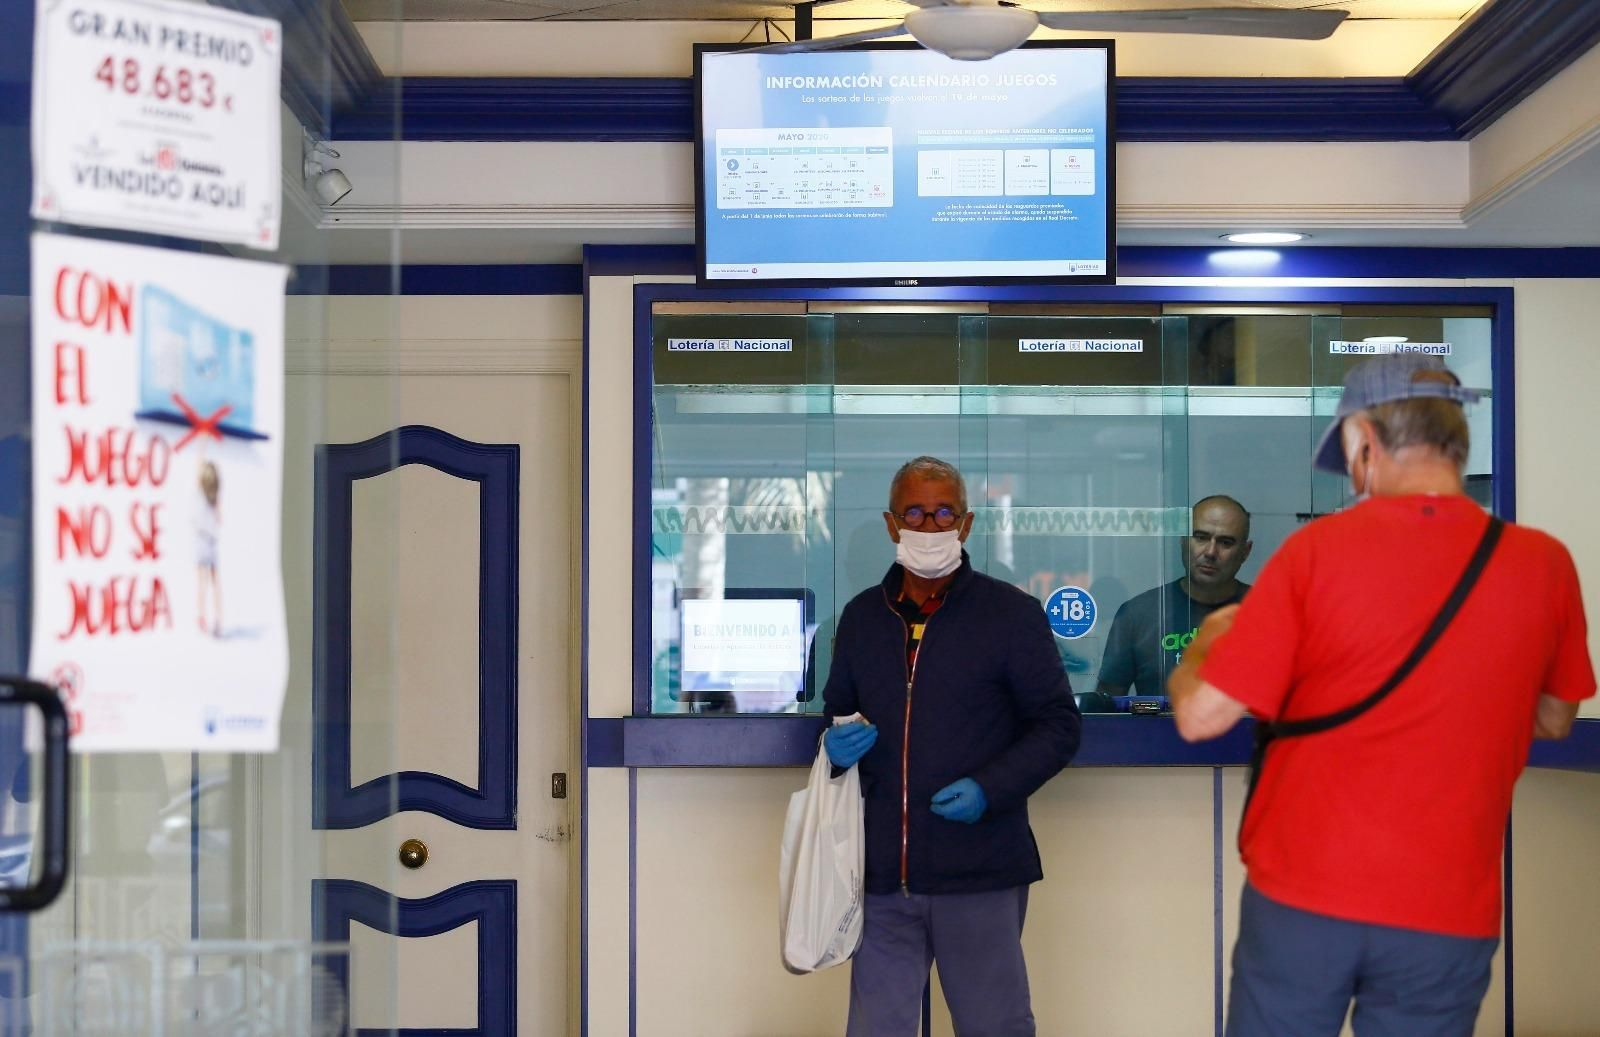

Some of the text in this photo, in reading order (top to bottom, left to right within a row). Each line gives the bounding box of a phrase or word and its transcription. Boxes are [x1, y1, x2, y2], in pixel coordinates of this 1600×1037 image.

[67, 9, 254, 68] GRAN PREMIO
[96, 55, 216, 109] 48.683
[766, 72, 1057, 89] INFORMACIÓN CALENDARIO JUEGOS
[818, 94, 847, 103] sorteos
[778, 133, 804, 141] MAYO
[72, 164, 184, 200] VENDIDO
[54, 265, 133, 337] CON
[669, 339, 790, 350] Lotería Nacional
[1021, 340, 1141, 351] Lotería Nacional
[1332, 342, 1450, 354] Lotería Nacional
[54, 341, 92, 407] EL
[57, 423, 172, 488] JUEGO
[57, 500, 165, 561] NO SE
[57, 574, 174, 641] JUEGA
[1050, 599, 1085, 621] +18
[694, 623, 777, 637] BIENVENIDO
[1162, 627, 1200, 650] ad
